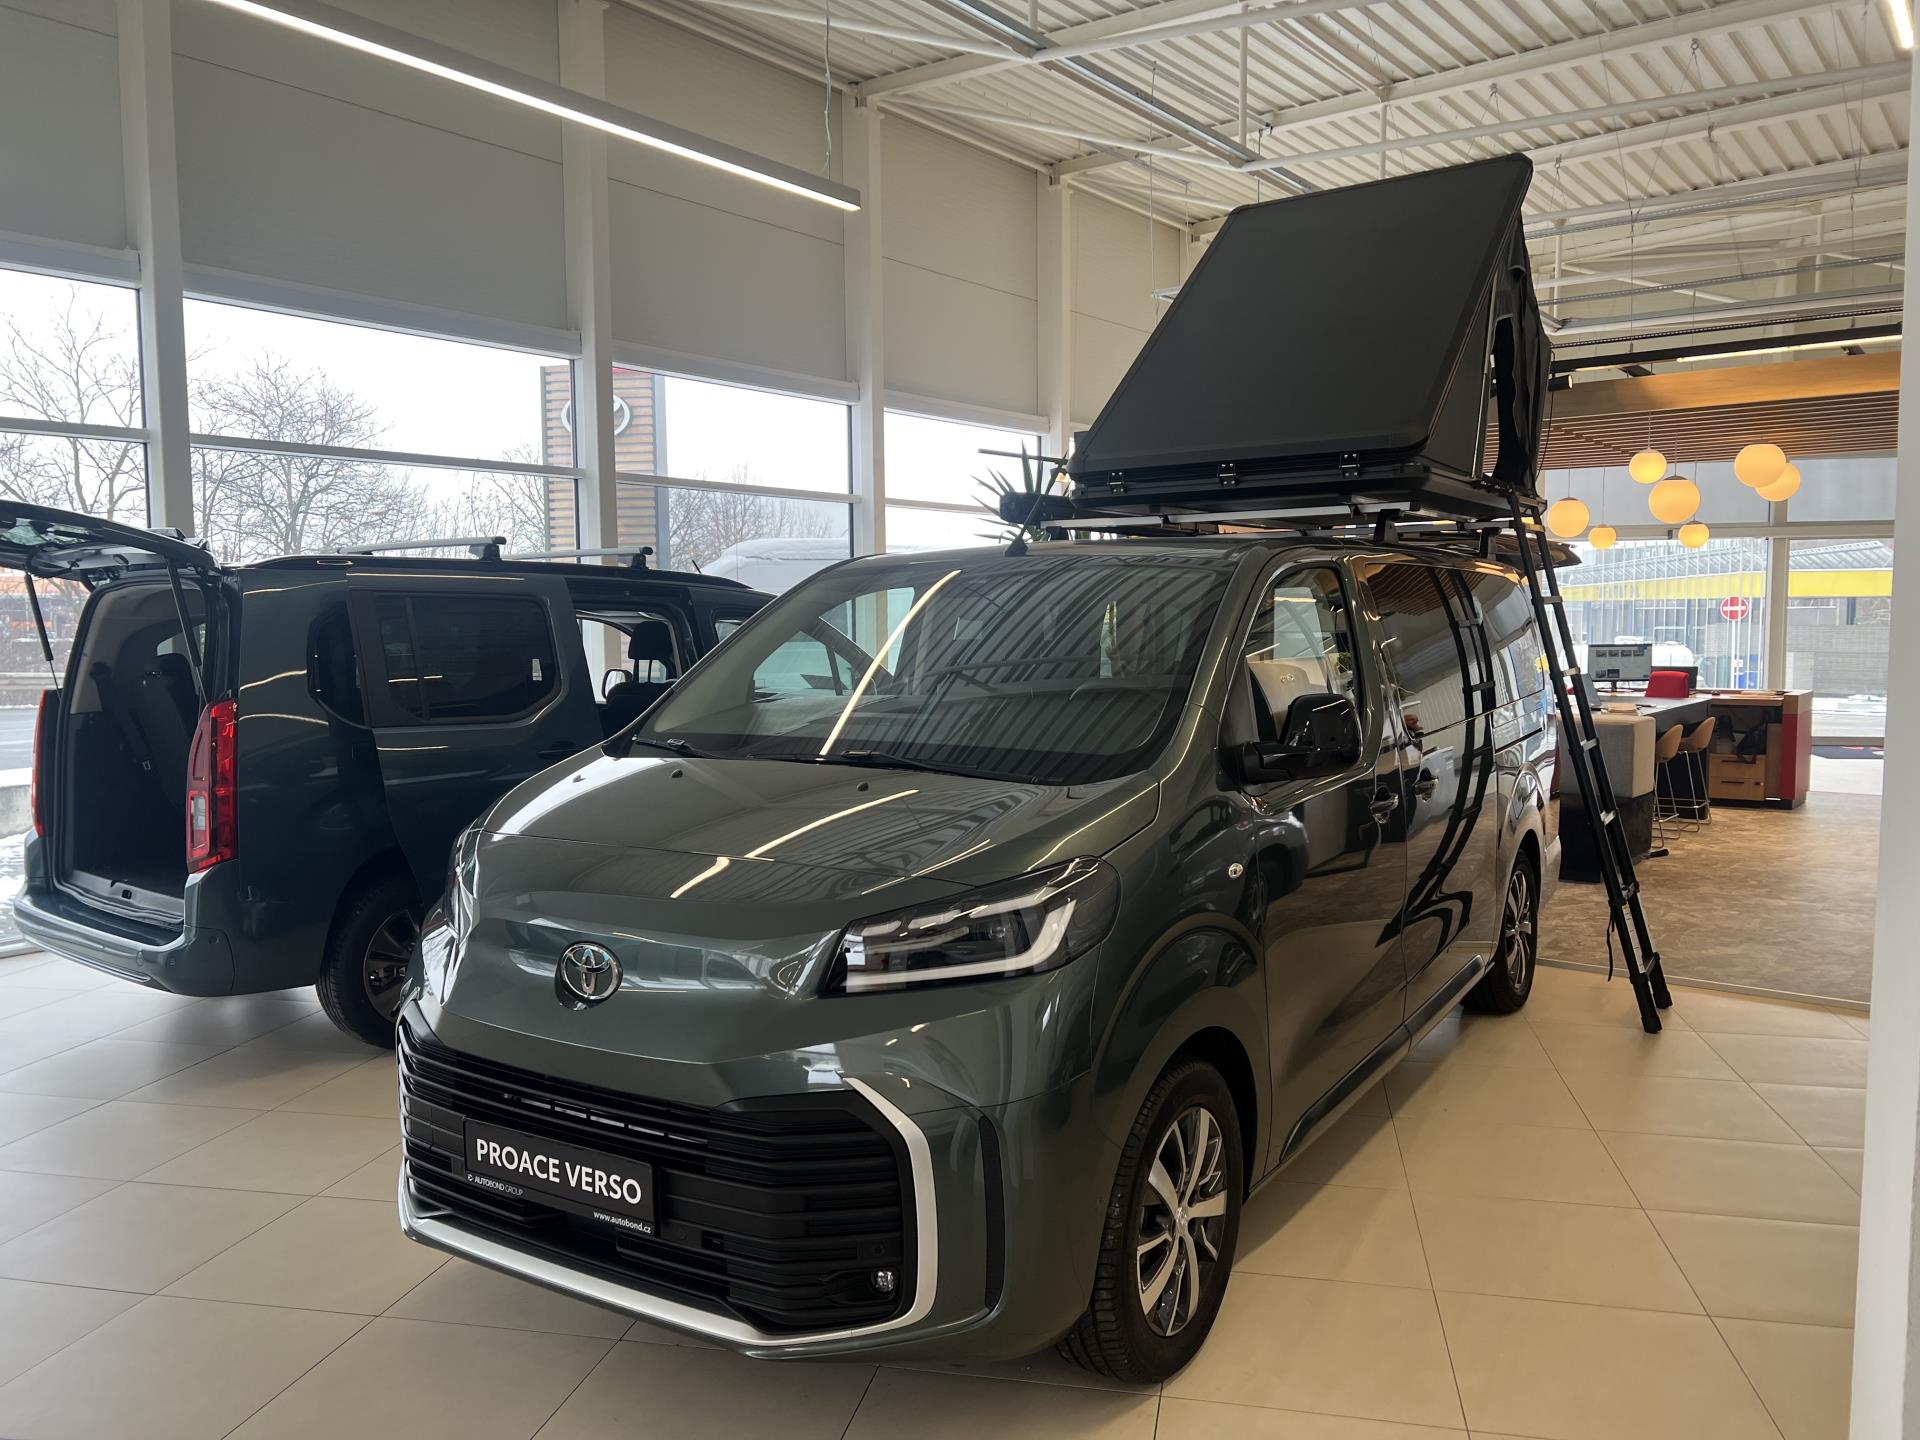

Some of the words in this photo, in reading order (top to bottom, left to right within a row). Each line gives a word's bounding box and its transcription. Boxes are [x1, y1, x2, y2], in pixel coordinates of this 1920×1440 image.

[476, 1138, 560, 1184] PROACE
[564, 1161, 642, 1205] VERSO
[474, 1175, 505, 1191] AUTOBOND
[505, 1184, 524, 1196] GROUP
[593, 1211, 651, 1233] www.autobond.cz
